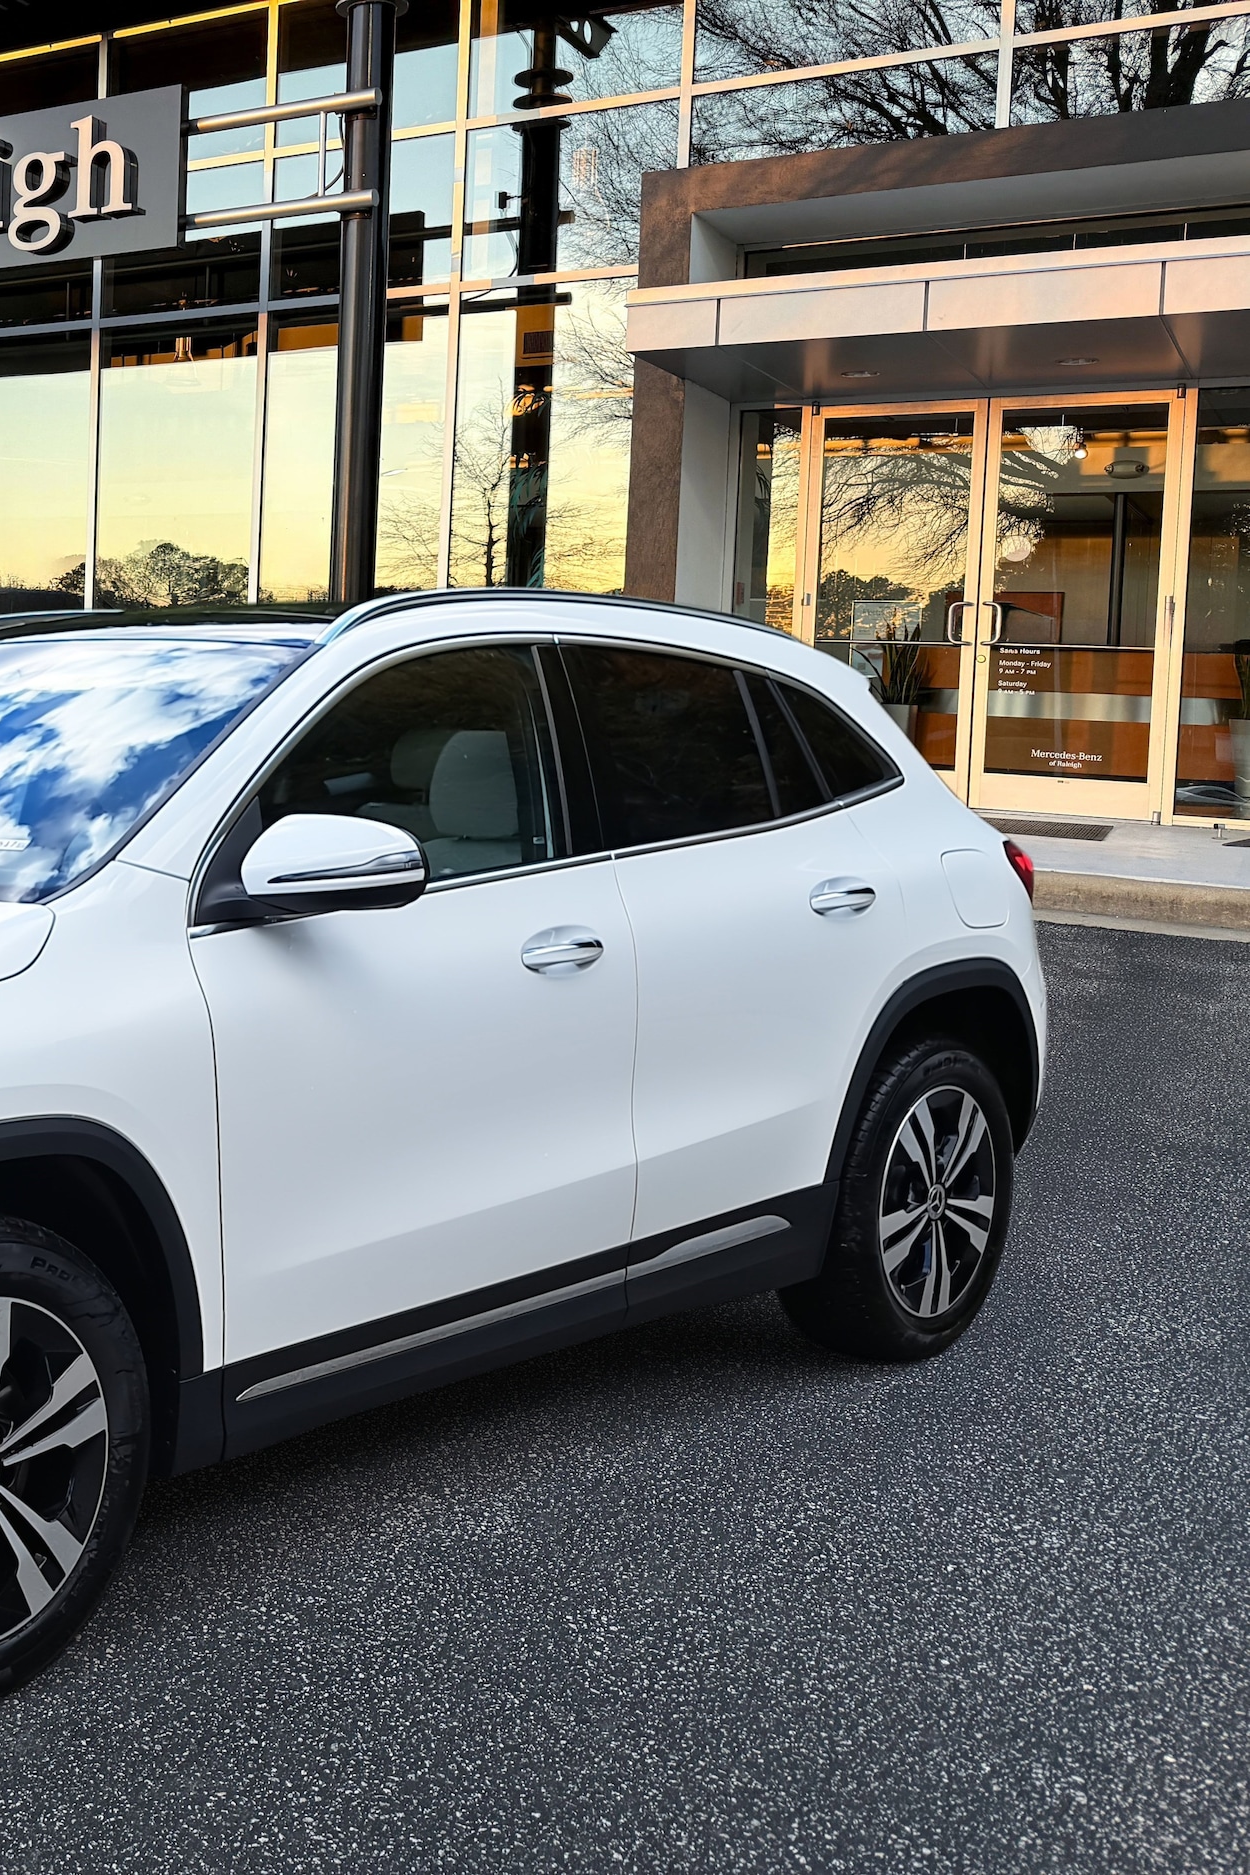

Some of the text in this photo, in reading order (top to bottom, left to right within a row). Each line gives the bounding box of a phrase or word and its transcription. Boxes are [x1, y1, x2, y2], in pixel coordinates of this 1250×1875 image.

[999, 660, 1025, 668] Monday
[998, 680, 1028, 688] Saturday
[1030, 748, 1103, 762] Mercedes-Benz
